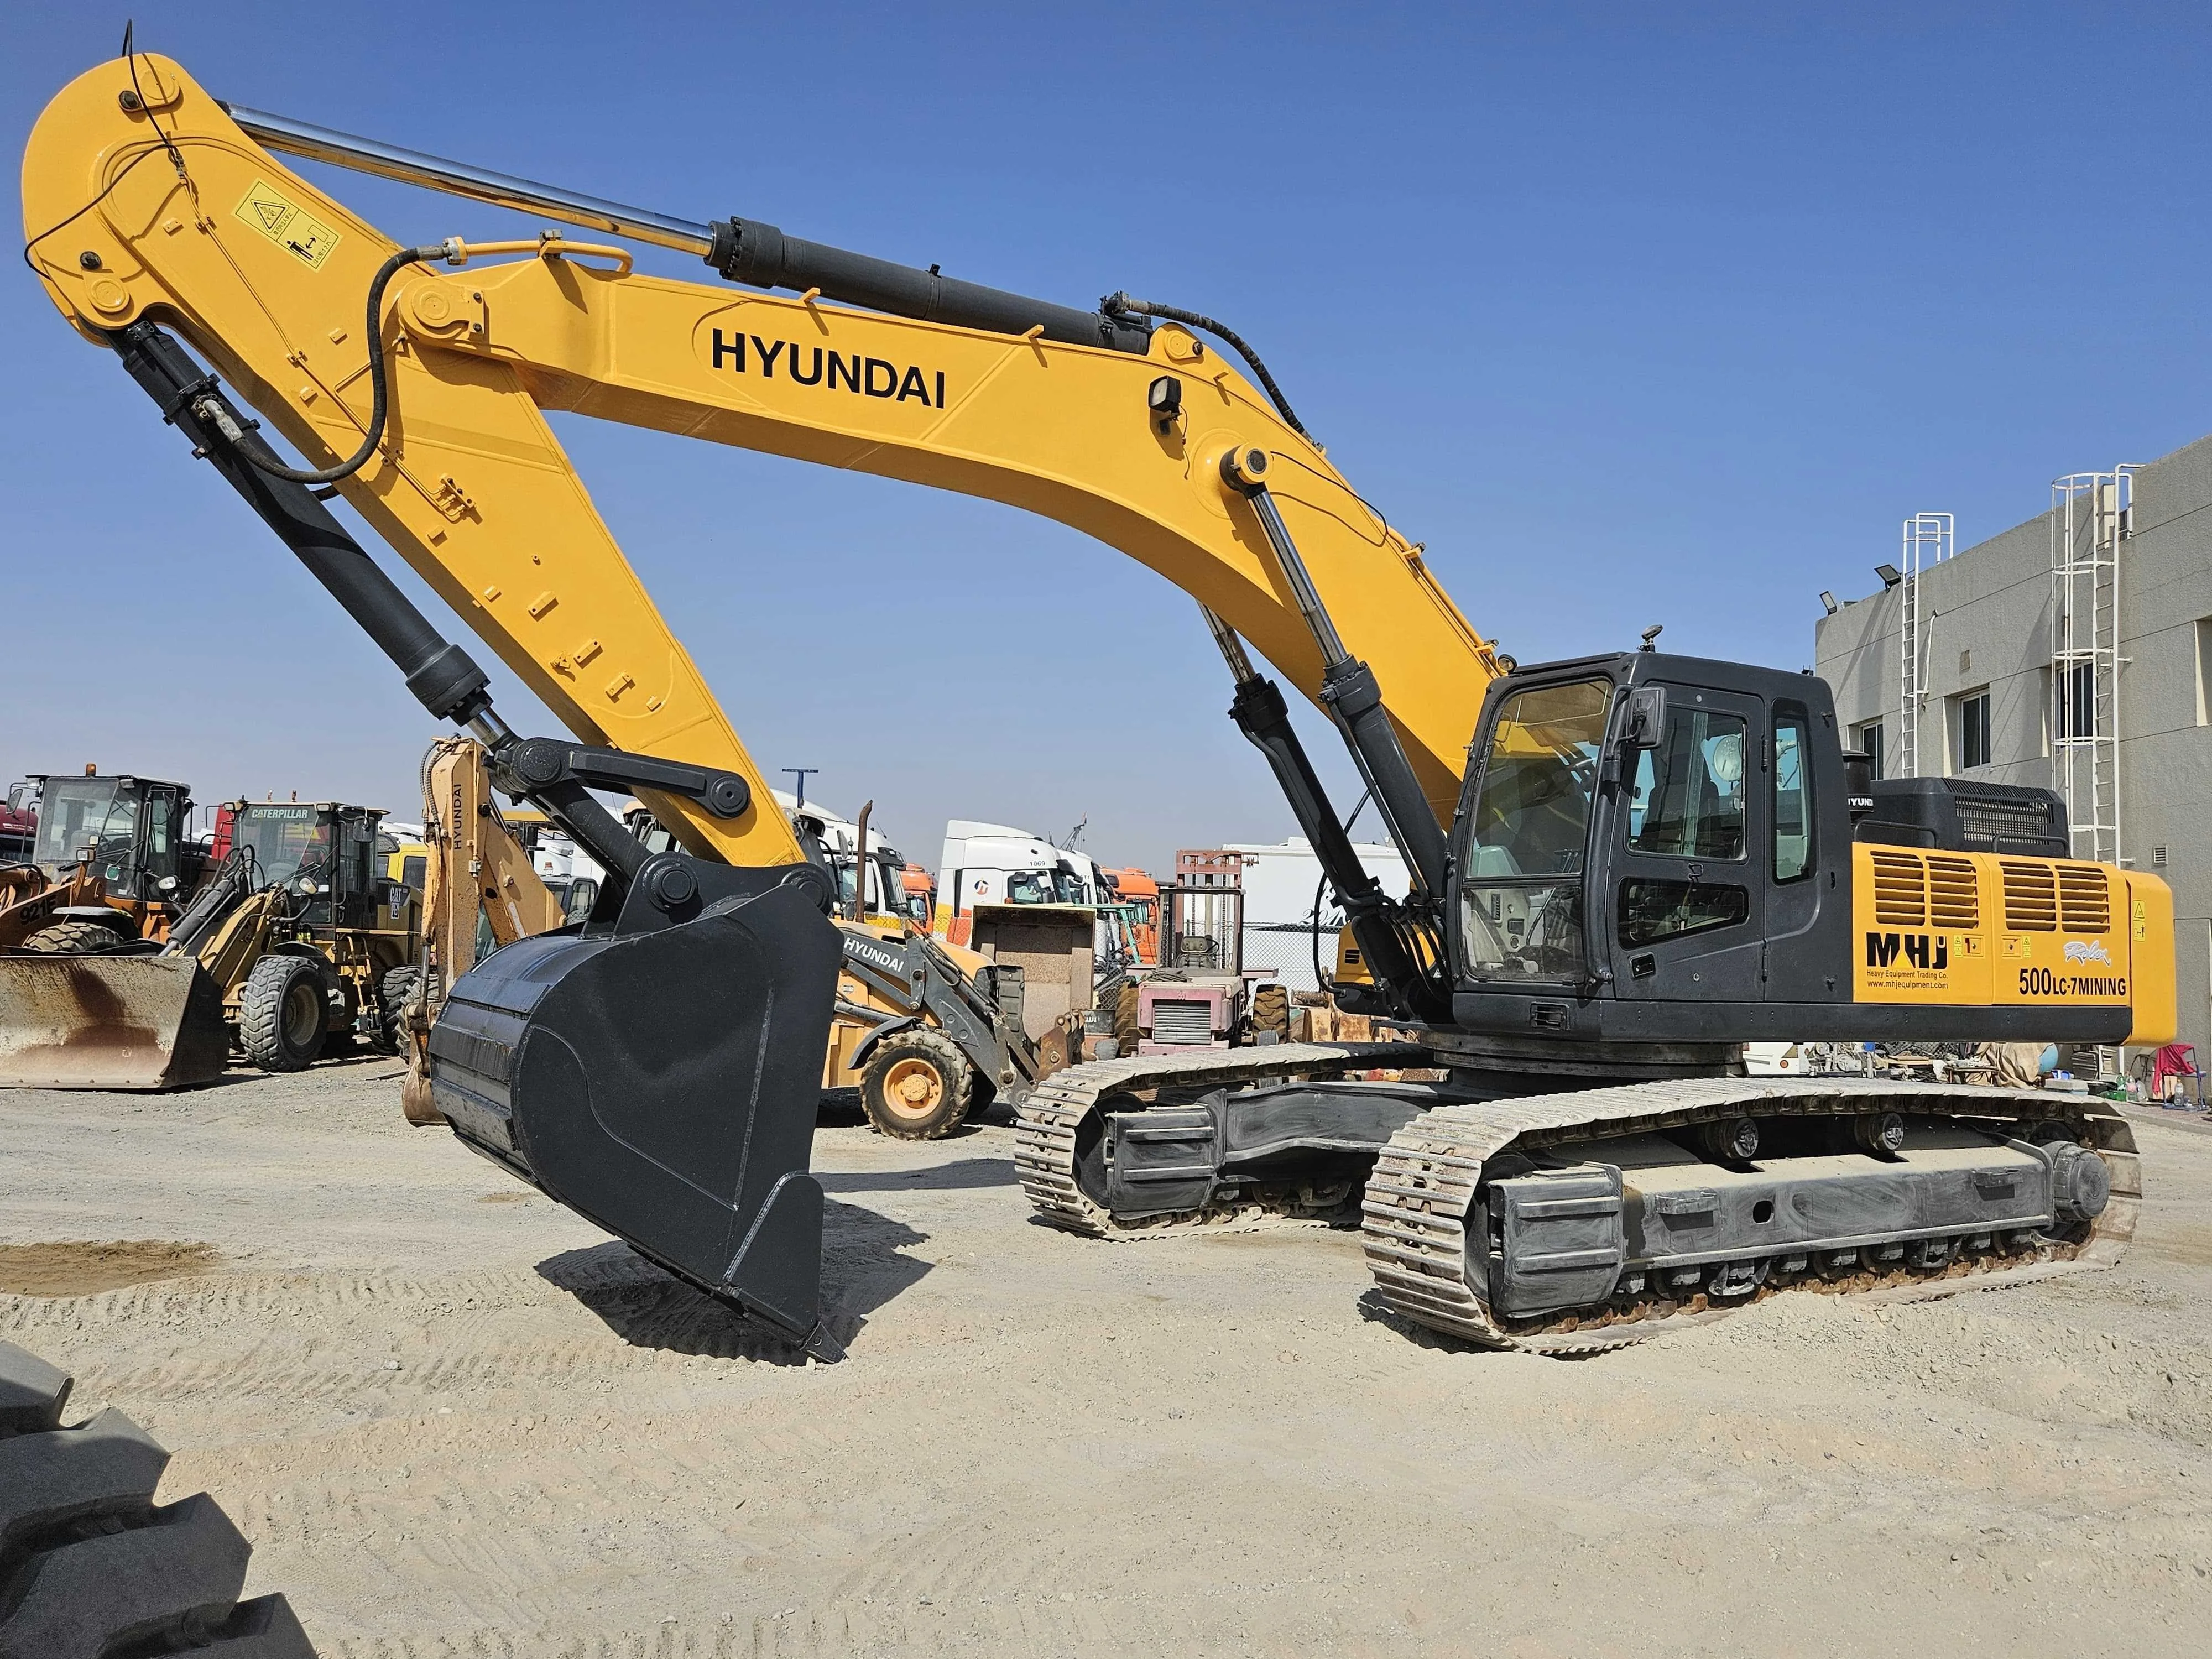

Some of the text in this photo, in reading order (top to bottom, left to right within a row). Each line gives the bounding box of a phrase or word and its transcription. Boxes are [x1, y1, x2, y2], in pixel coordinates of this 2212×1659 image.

[712, 328, 945, 409] HYUNDAI
[252, 809, 308, 819] CATERPILLAR
[453, 784, 462, 850] HYUNDAI
[390, 886, 403, 903] CAT
[20, 894, 56, 925] 921E
[843, 937, 905, 973] HYUNDAI
[1866, 969, 1884, 978] Heavy
[1885, 970, 1915, 978] Equipment
[1917, 971, 1937, 980] Trading
[1867, 979, 1948, 990] www.mhjequipment.com
